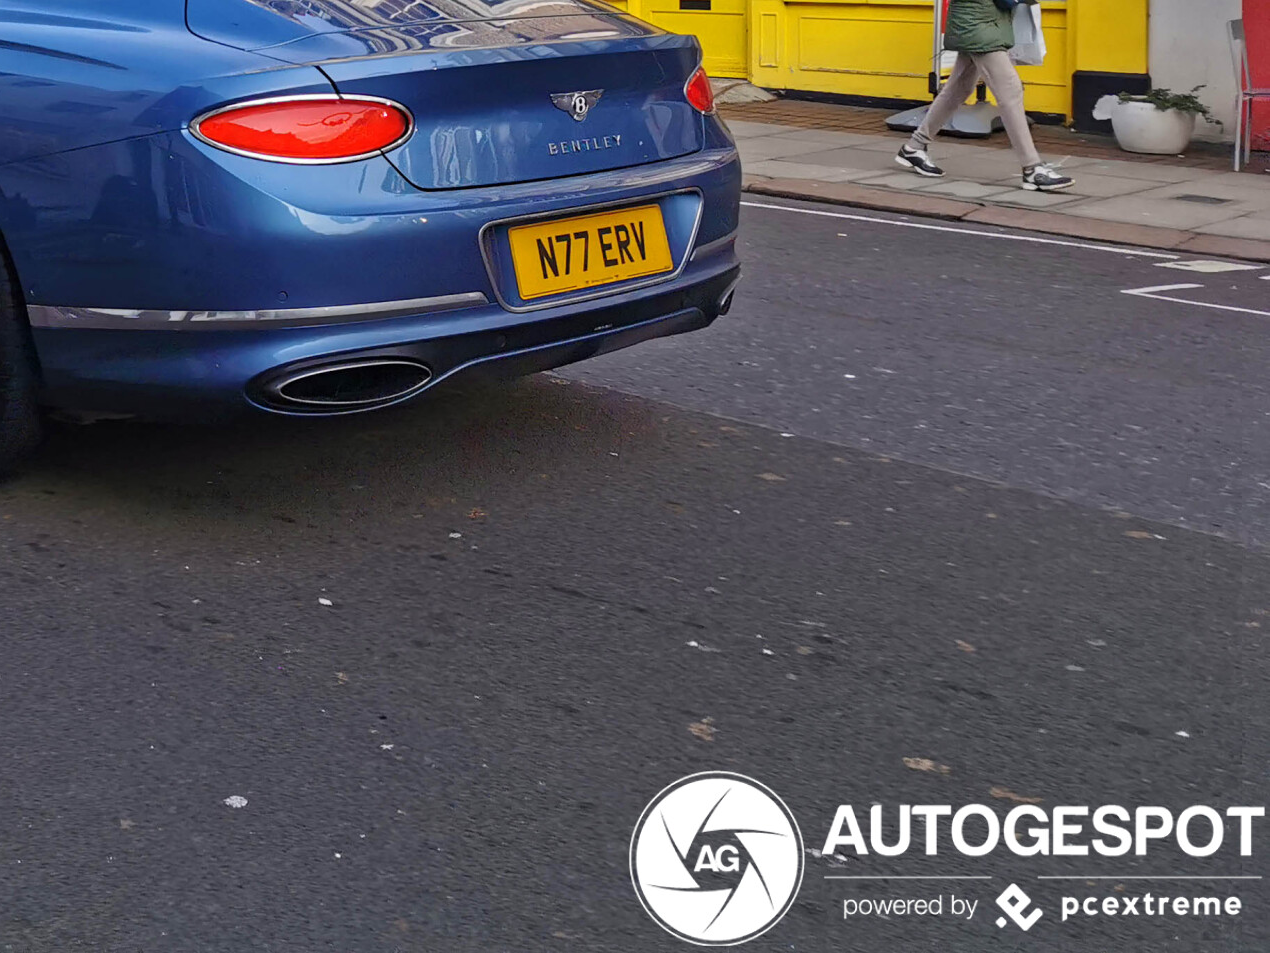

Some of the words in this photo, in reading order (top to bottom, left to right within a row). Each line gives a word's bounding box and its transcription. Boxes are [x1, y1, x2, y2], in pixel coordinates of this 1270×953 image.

[548, 134, 622, 155] BENTLEY
[536, 230, 590, 280] N77
[597, 221, 647, 268] ERV
